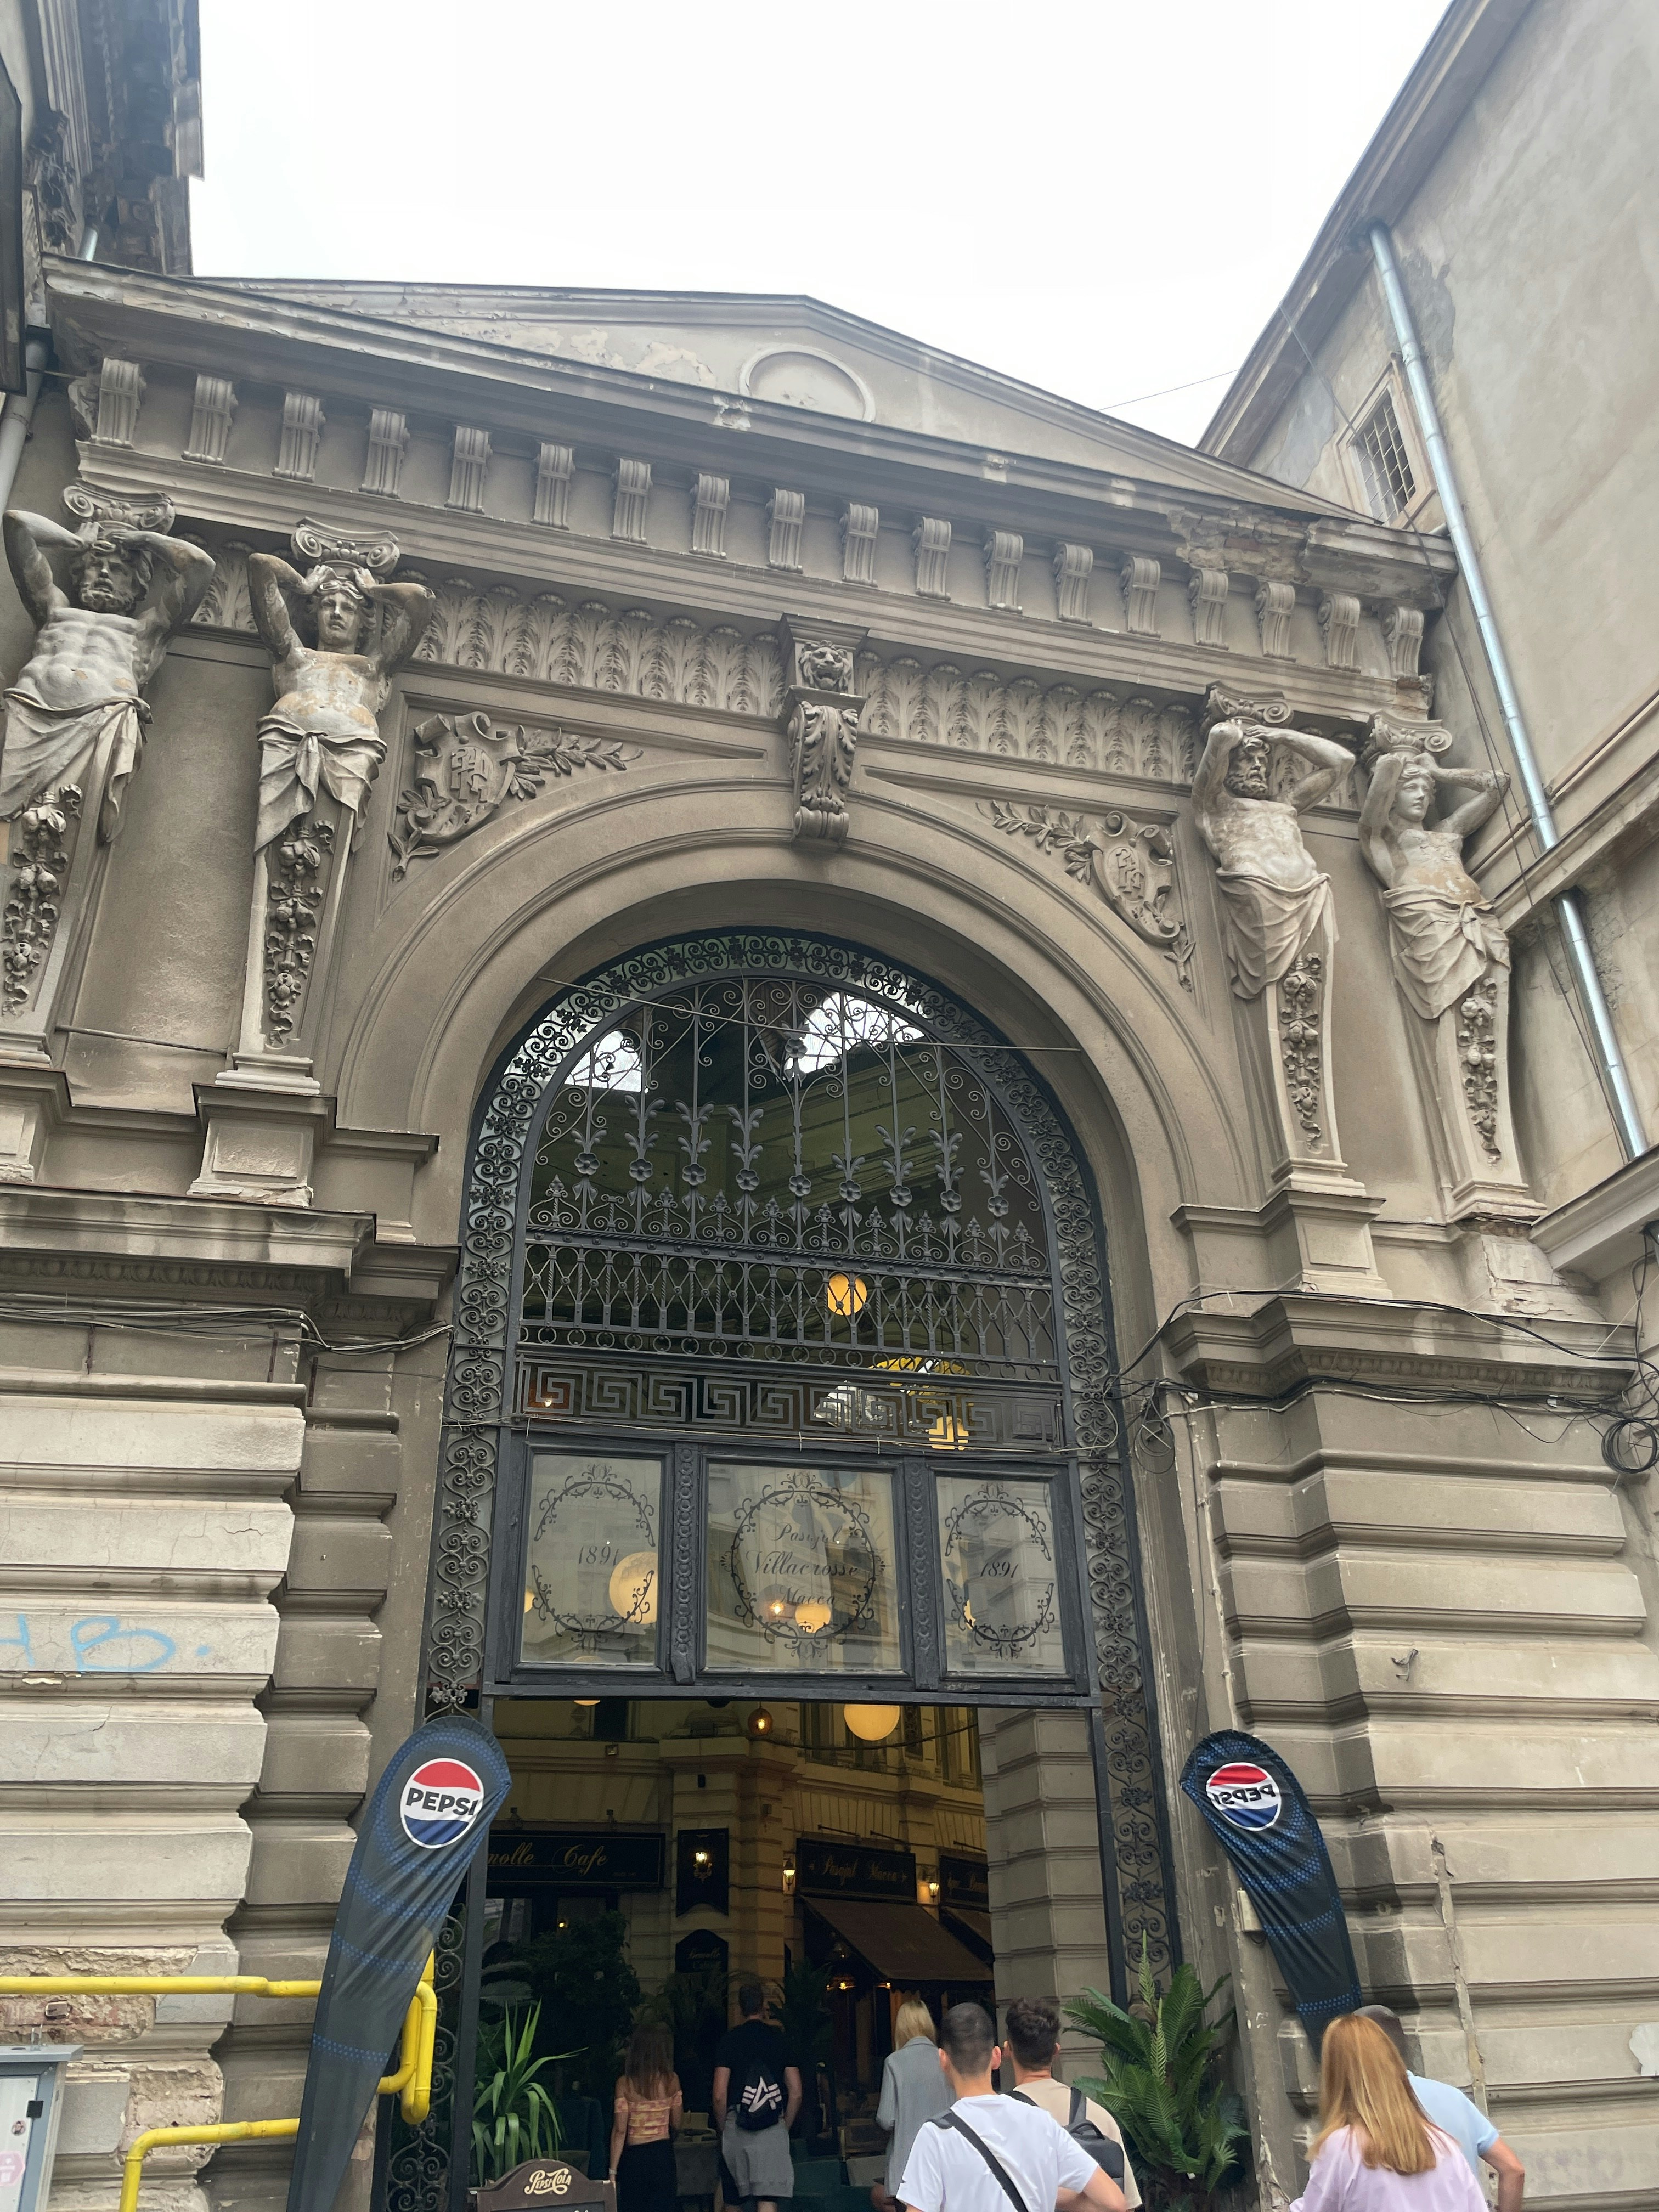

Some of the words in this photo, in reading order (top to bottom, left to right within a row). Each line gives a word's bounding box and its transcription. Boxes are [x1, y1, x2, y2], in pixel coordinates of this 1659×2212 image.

[579, 1545, 619, 1566] 1891
[746, 1550, 857, 1576] Villacrosse
[980, 1561, 1019, 1578] 1891
[780, 1587, 834, 1605] Macca
[406, 1787, 478, 1815] PEPSI
[550, 1844, 608, 1876] Cafe
